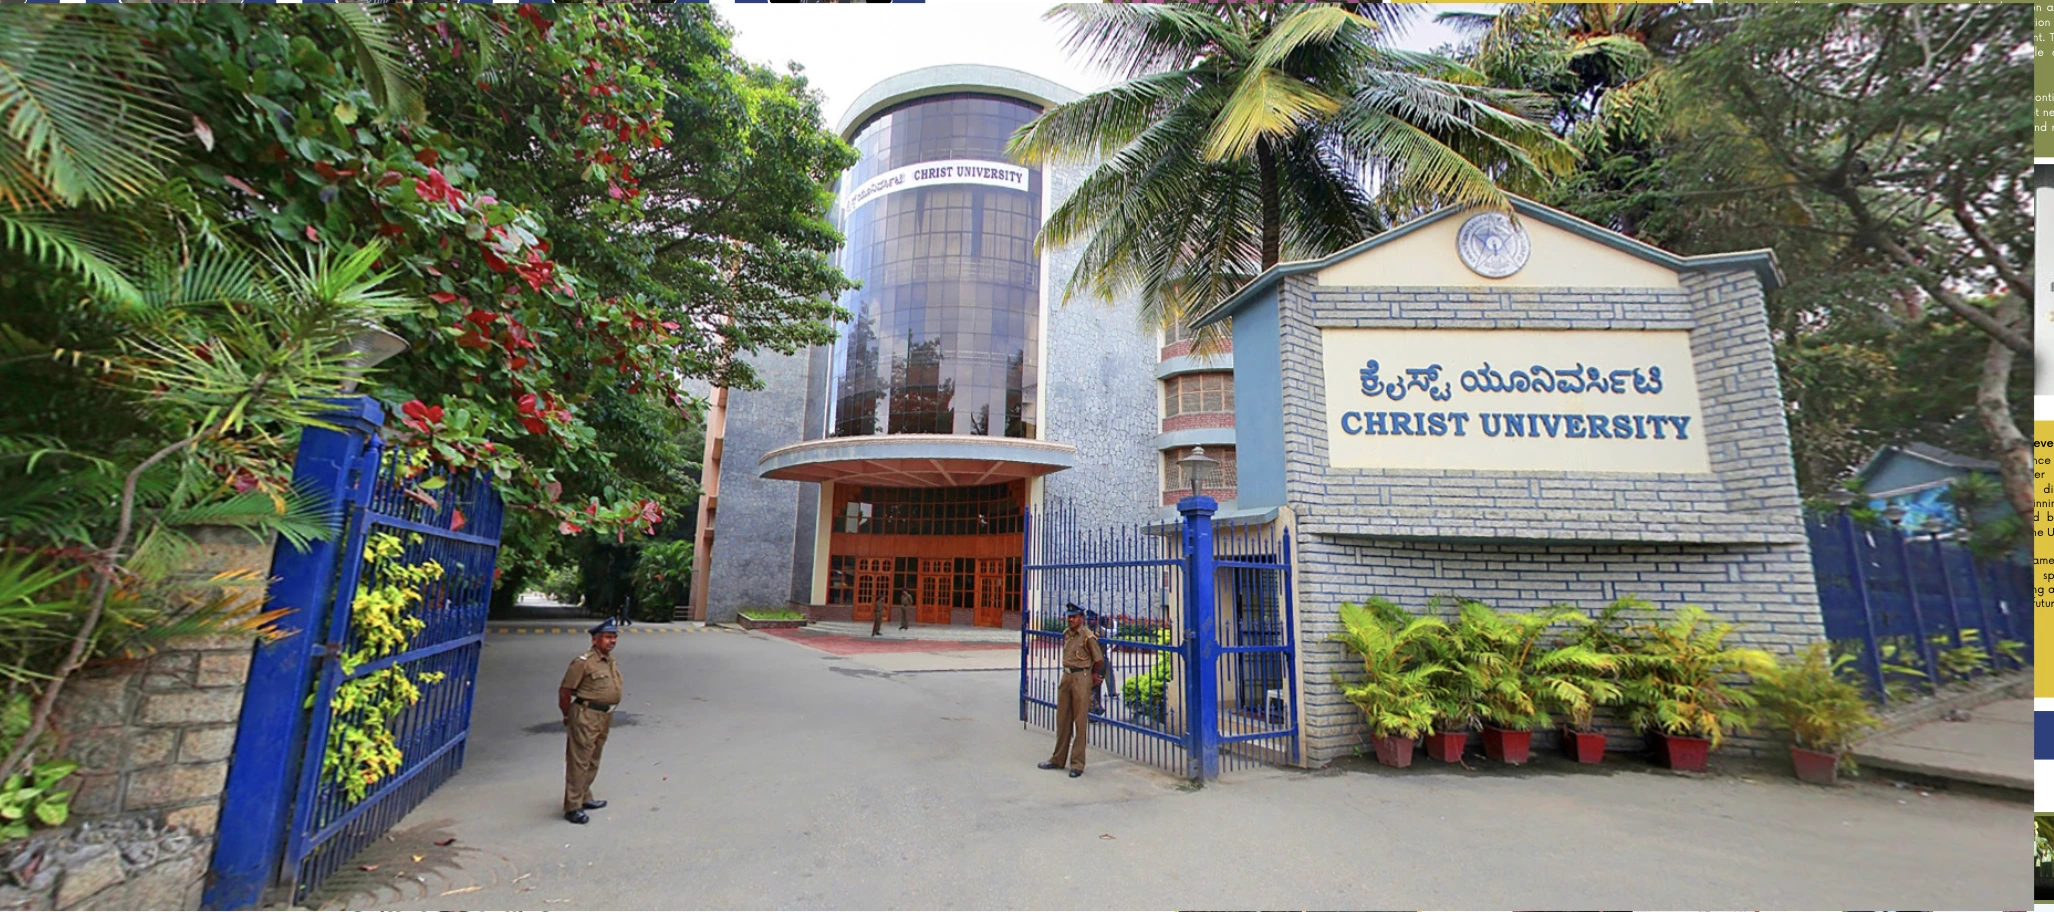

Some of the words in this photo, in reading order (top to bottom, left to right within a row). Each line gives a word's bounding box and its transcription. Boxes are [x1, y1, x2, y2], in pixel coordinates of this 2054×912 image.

[2034, 18, 2050, 26] ion
[914, 166, 953, 180] CHRIST
[957, 166, 1023, 183] UNIVERSITY
[1341, 411, 1469, 436] CHRIST
[1479, 413, 1691, 440] UNIVERSITY
